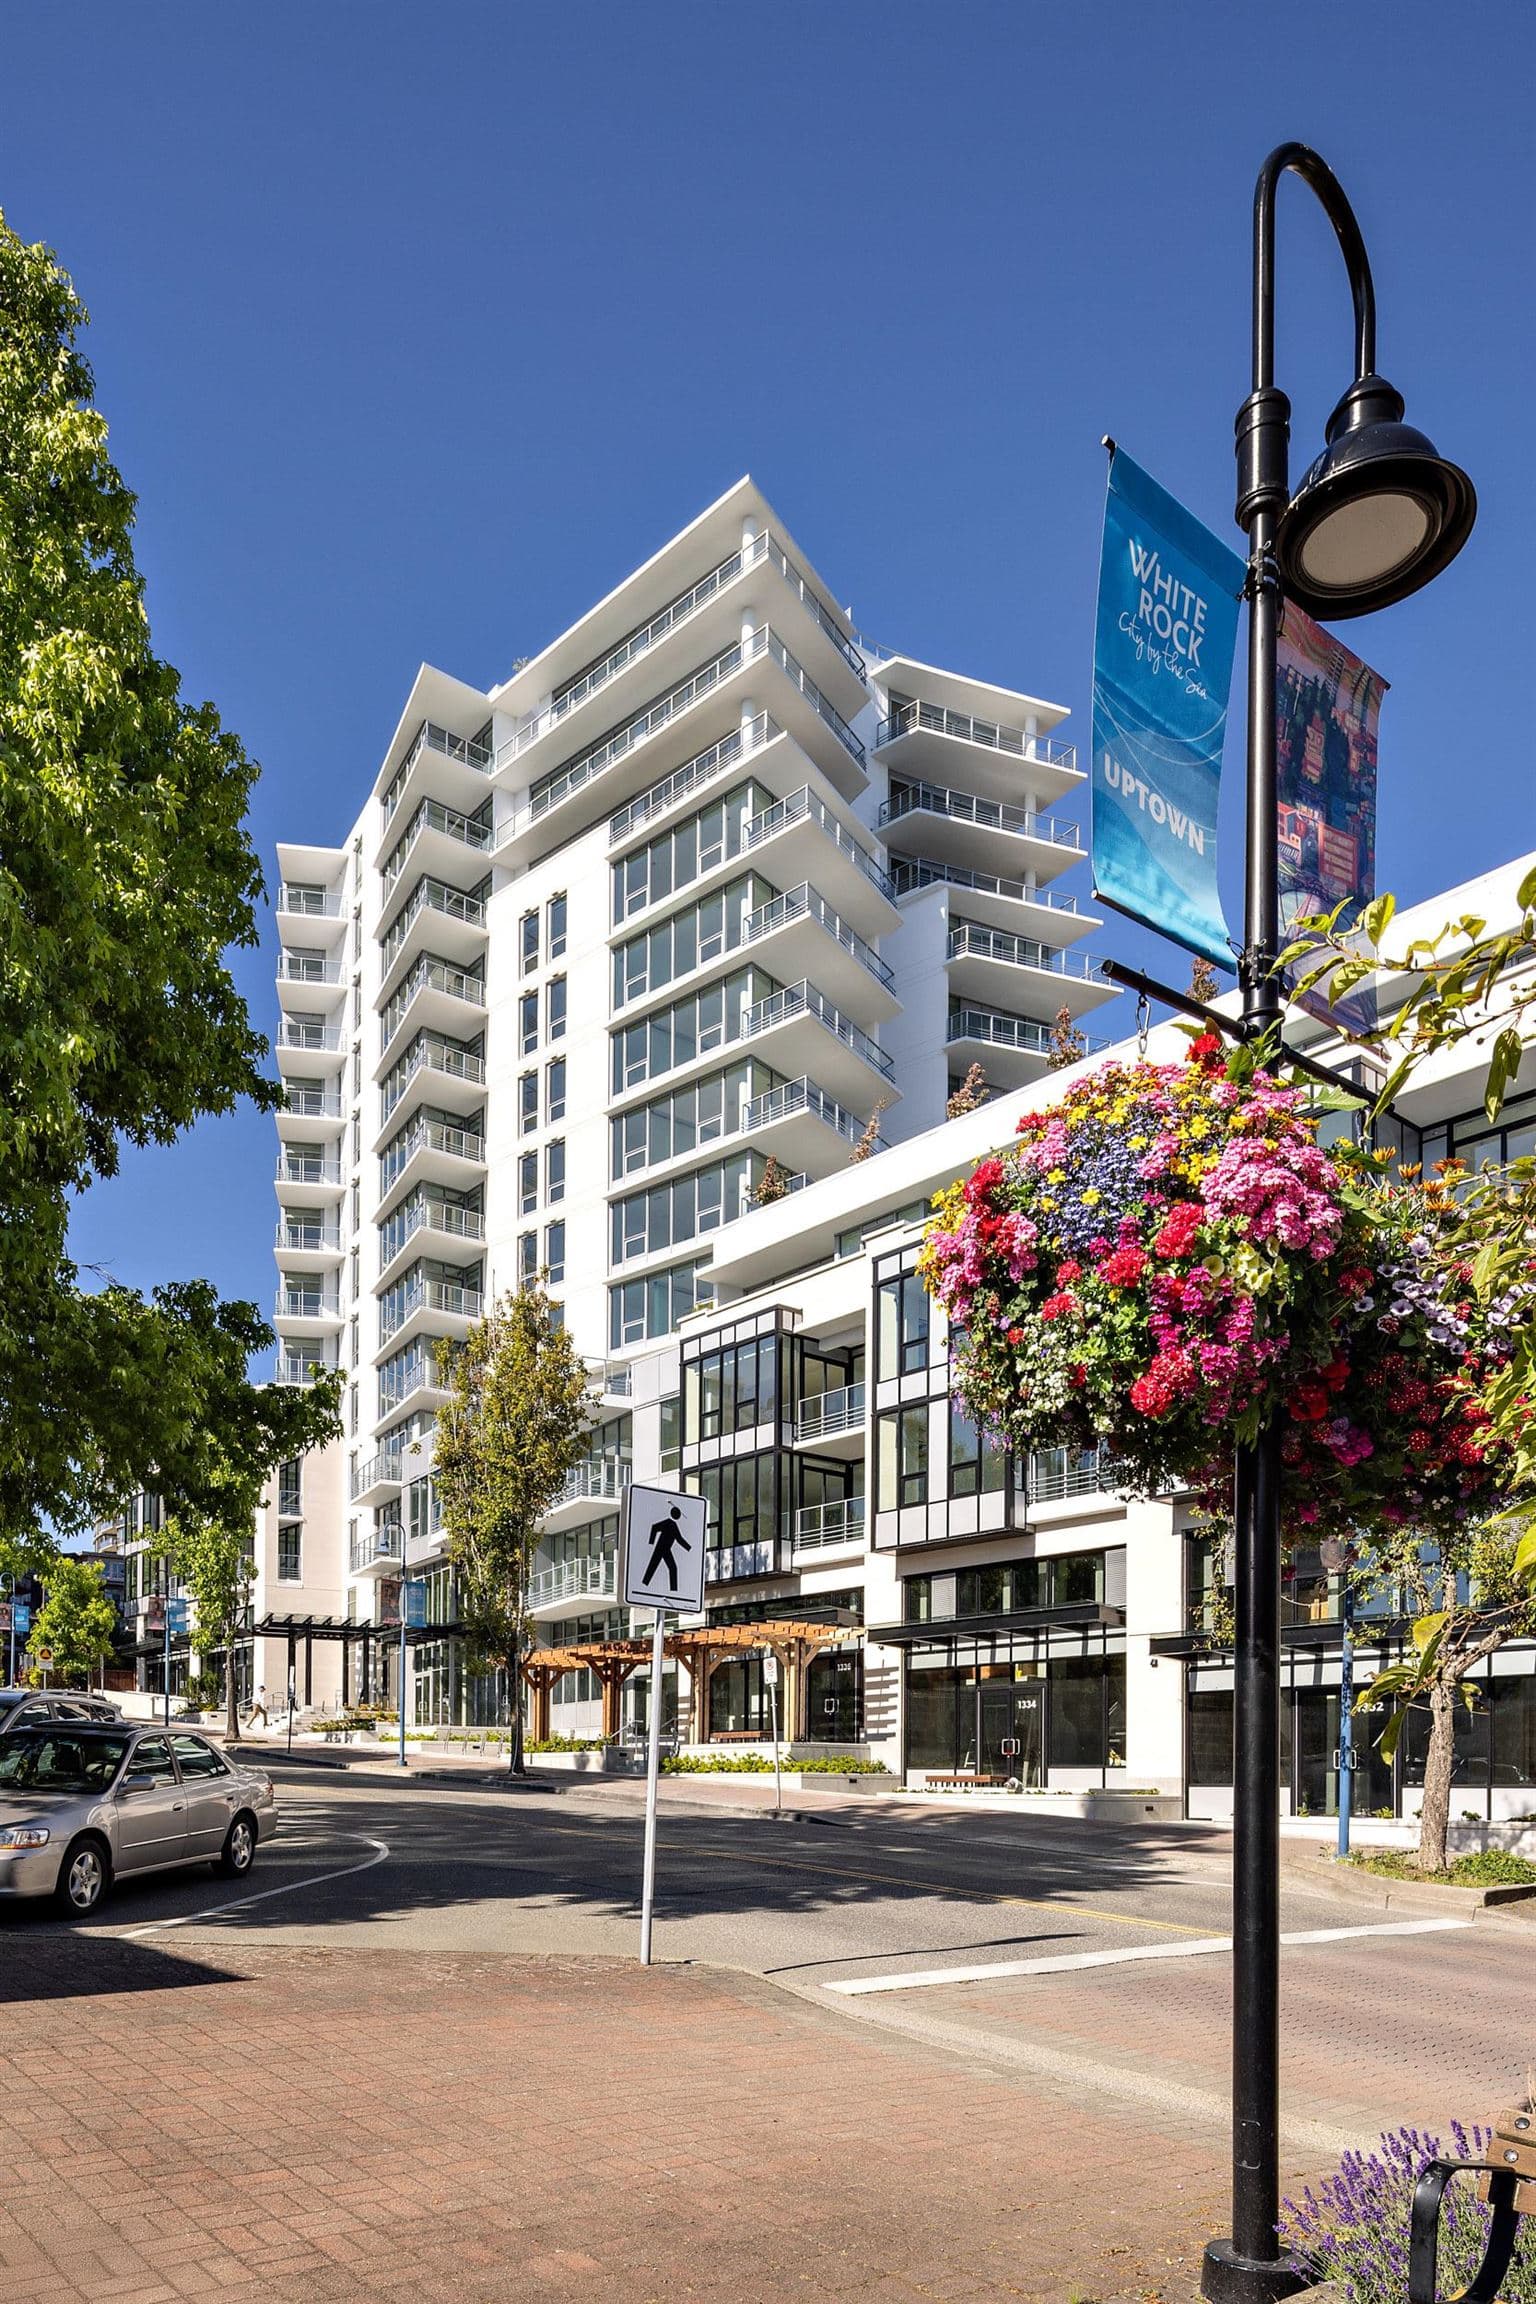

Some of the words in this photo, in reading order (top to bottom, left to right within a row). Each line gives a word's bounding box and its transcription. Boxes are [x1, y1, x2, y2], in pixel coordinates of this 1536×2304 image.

[1129, 538, 1208, 634] WHITE
[1138, 587, 1204, 668] ROCK
[1118, 611, 1145, 661] City
[1146, 632, 1162, 675] by
[1162, 642, 1184, 680] the
[1185, 668, 1208, 700] Sea
[1104, 752, 1204, 856] UPTOWN
[1017, 1700, 1037, 1710] 1334
